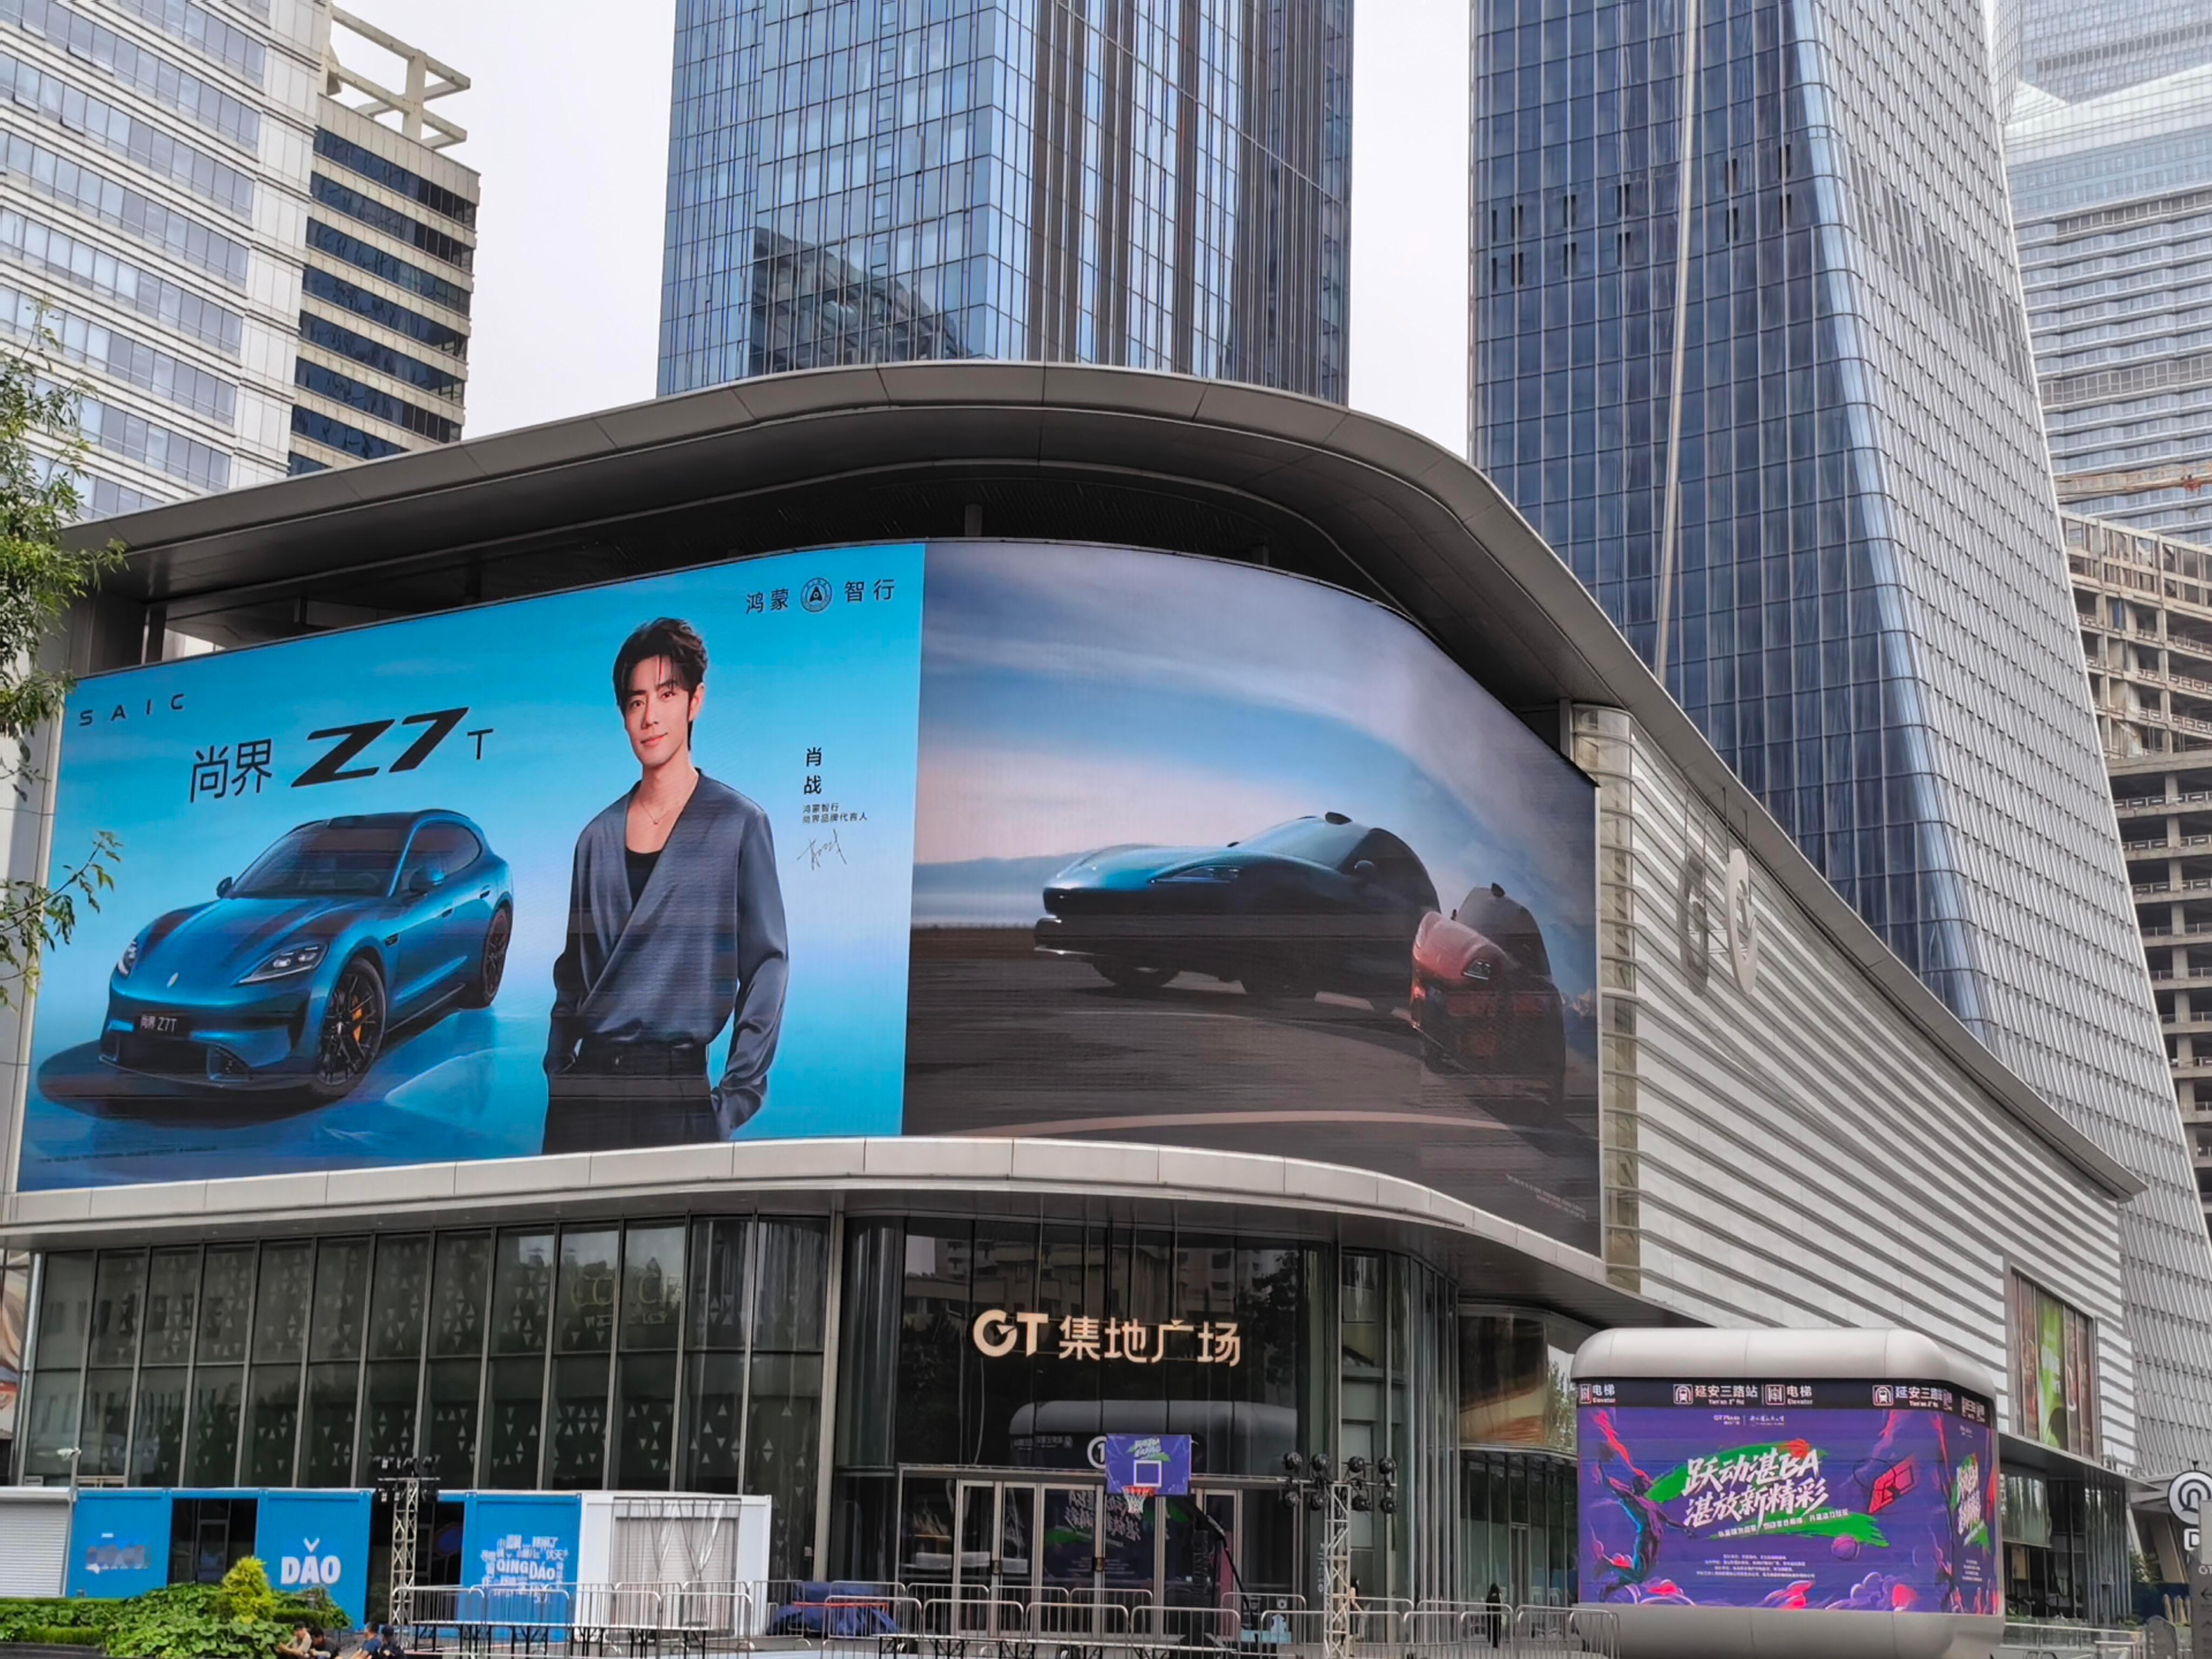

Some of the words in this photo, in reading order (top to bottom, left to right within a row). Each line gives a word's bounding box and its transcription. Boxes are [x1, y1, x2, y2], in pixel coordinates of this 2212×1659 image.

[746, 588, 789, 615] 鸿蒙
[844, 579, 895, 603] 智行
[79, 694, 186, 726] SAIC
[190, 738, 272, 803] 尚界
[804, 747, 822, 795] 肖战
[973, 1309, 1049, 1357] GT
[1058, 1314, 1241, 1367] 集地广场
[1593, 1384, 1615, 1396] 电梯
[1695, 1385, 1758, 1398] 延安三路站
[1786, 1385, 1812, 1398] 电梯
[1682, 1447, 1819, 1496] 跃动湛BA
[1683, 1477, 1830, 1535] 湛放新精彩
